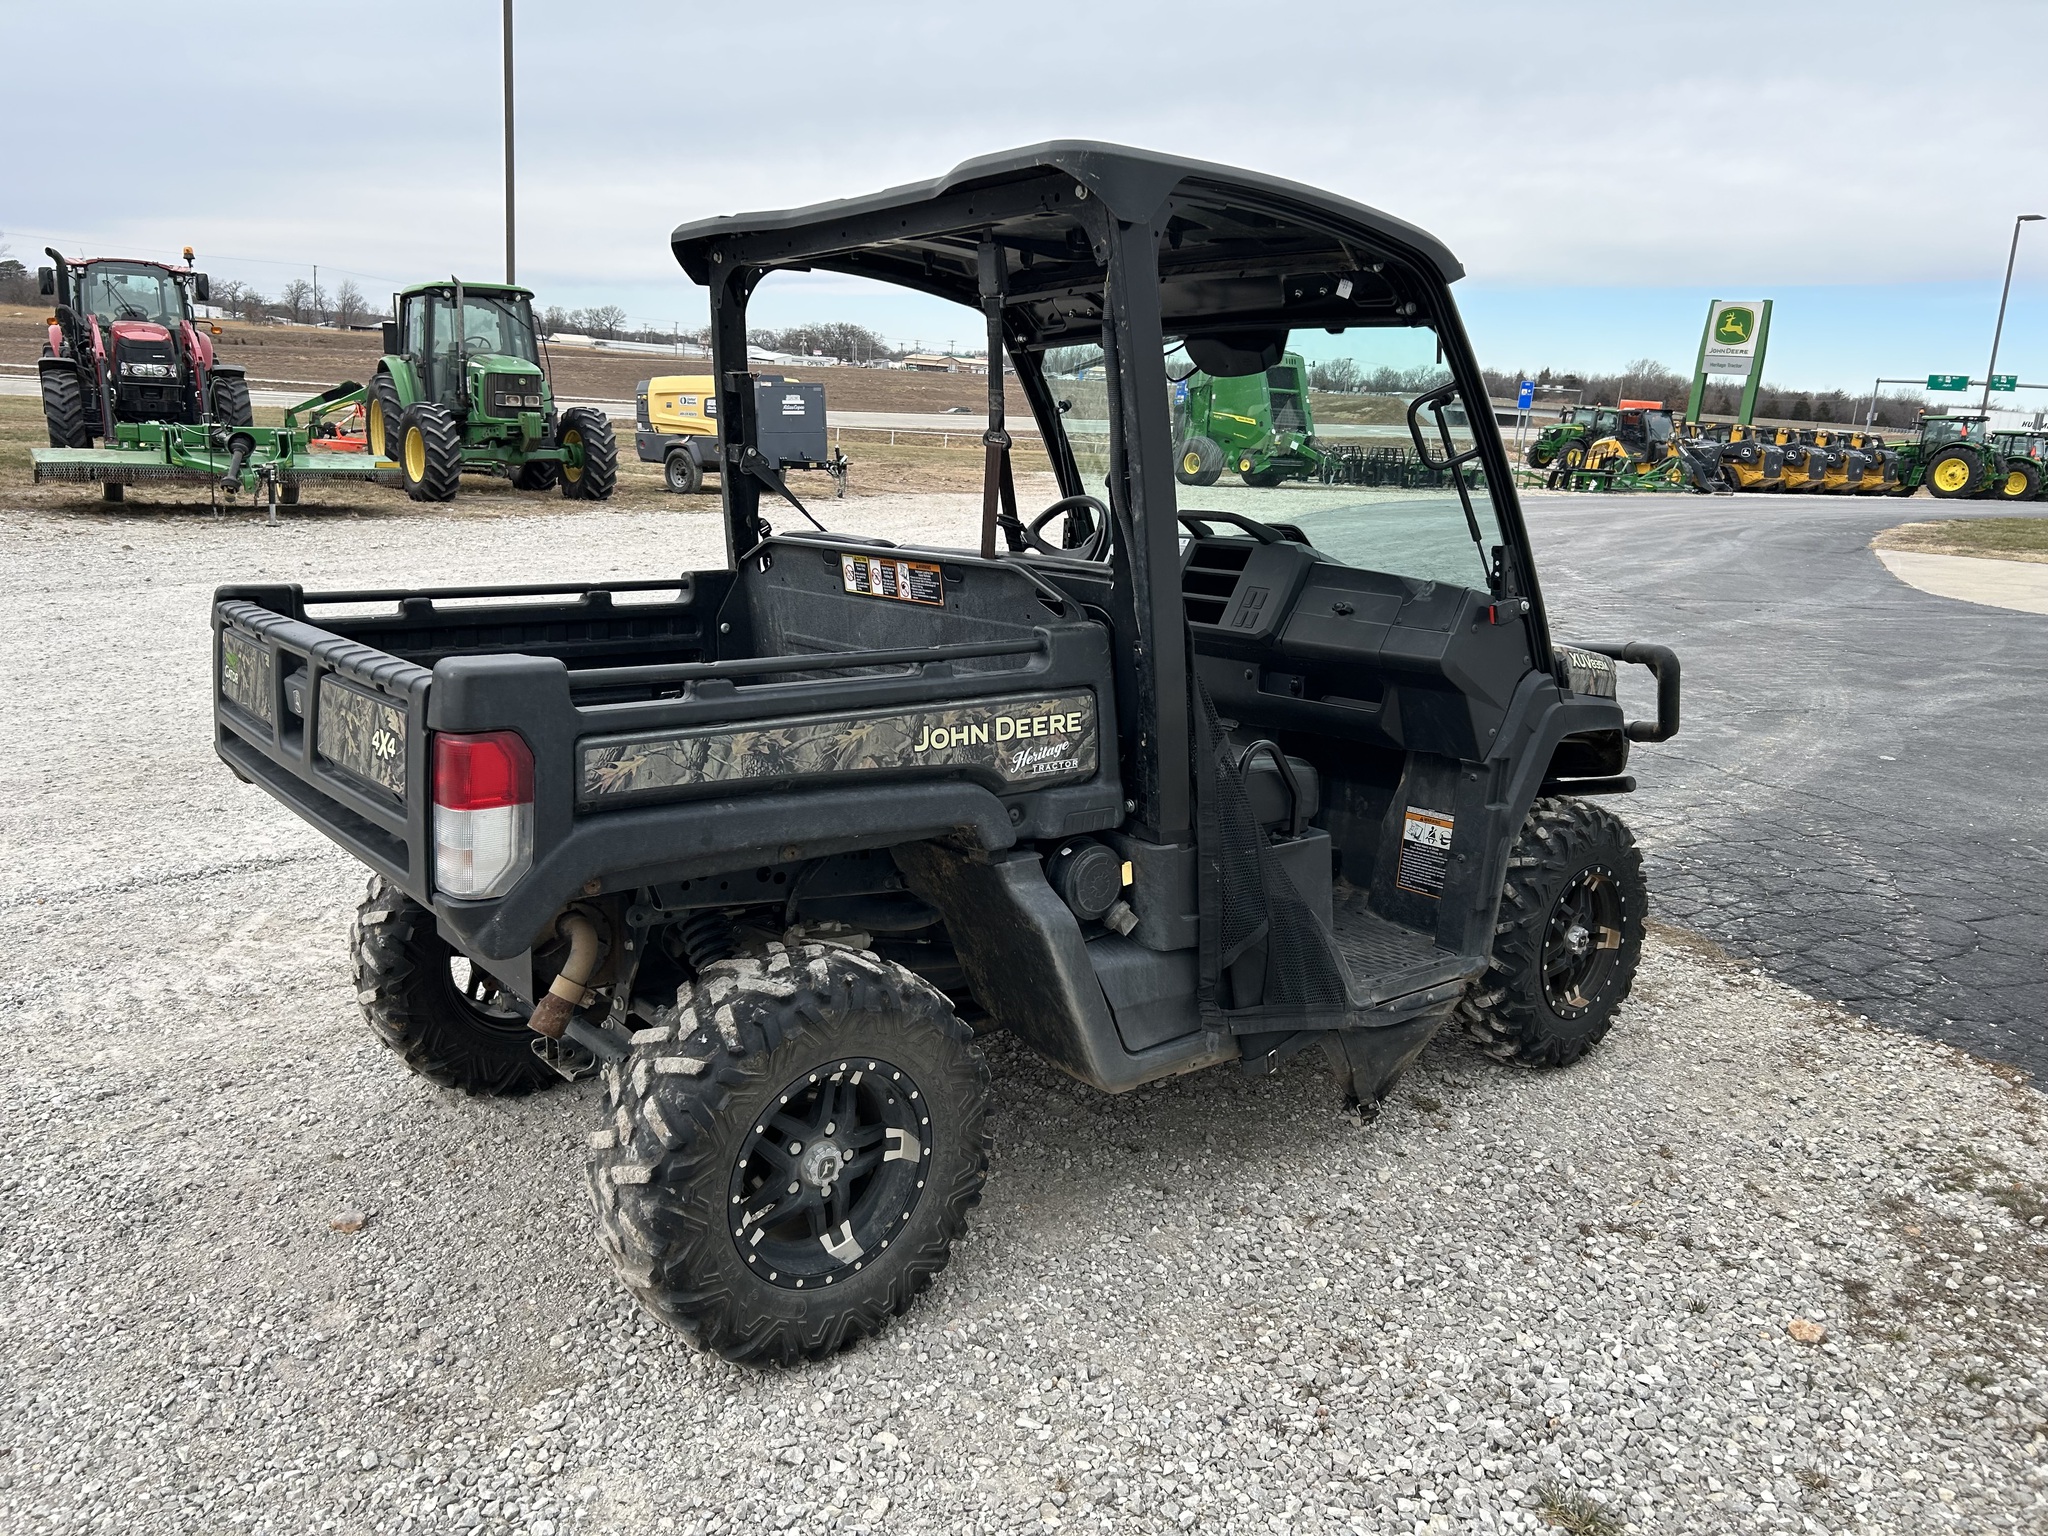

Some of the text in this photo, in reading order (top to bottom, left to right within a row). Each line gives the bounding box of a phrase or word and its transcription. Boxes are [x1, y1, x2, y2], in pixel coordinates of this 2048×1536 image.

[914, 711, 1083, 753] JOHN DEERE
[1010, 740, 1070, 774] Heritage
[1032, 758, 1079, 773] TRACTOR
